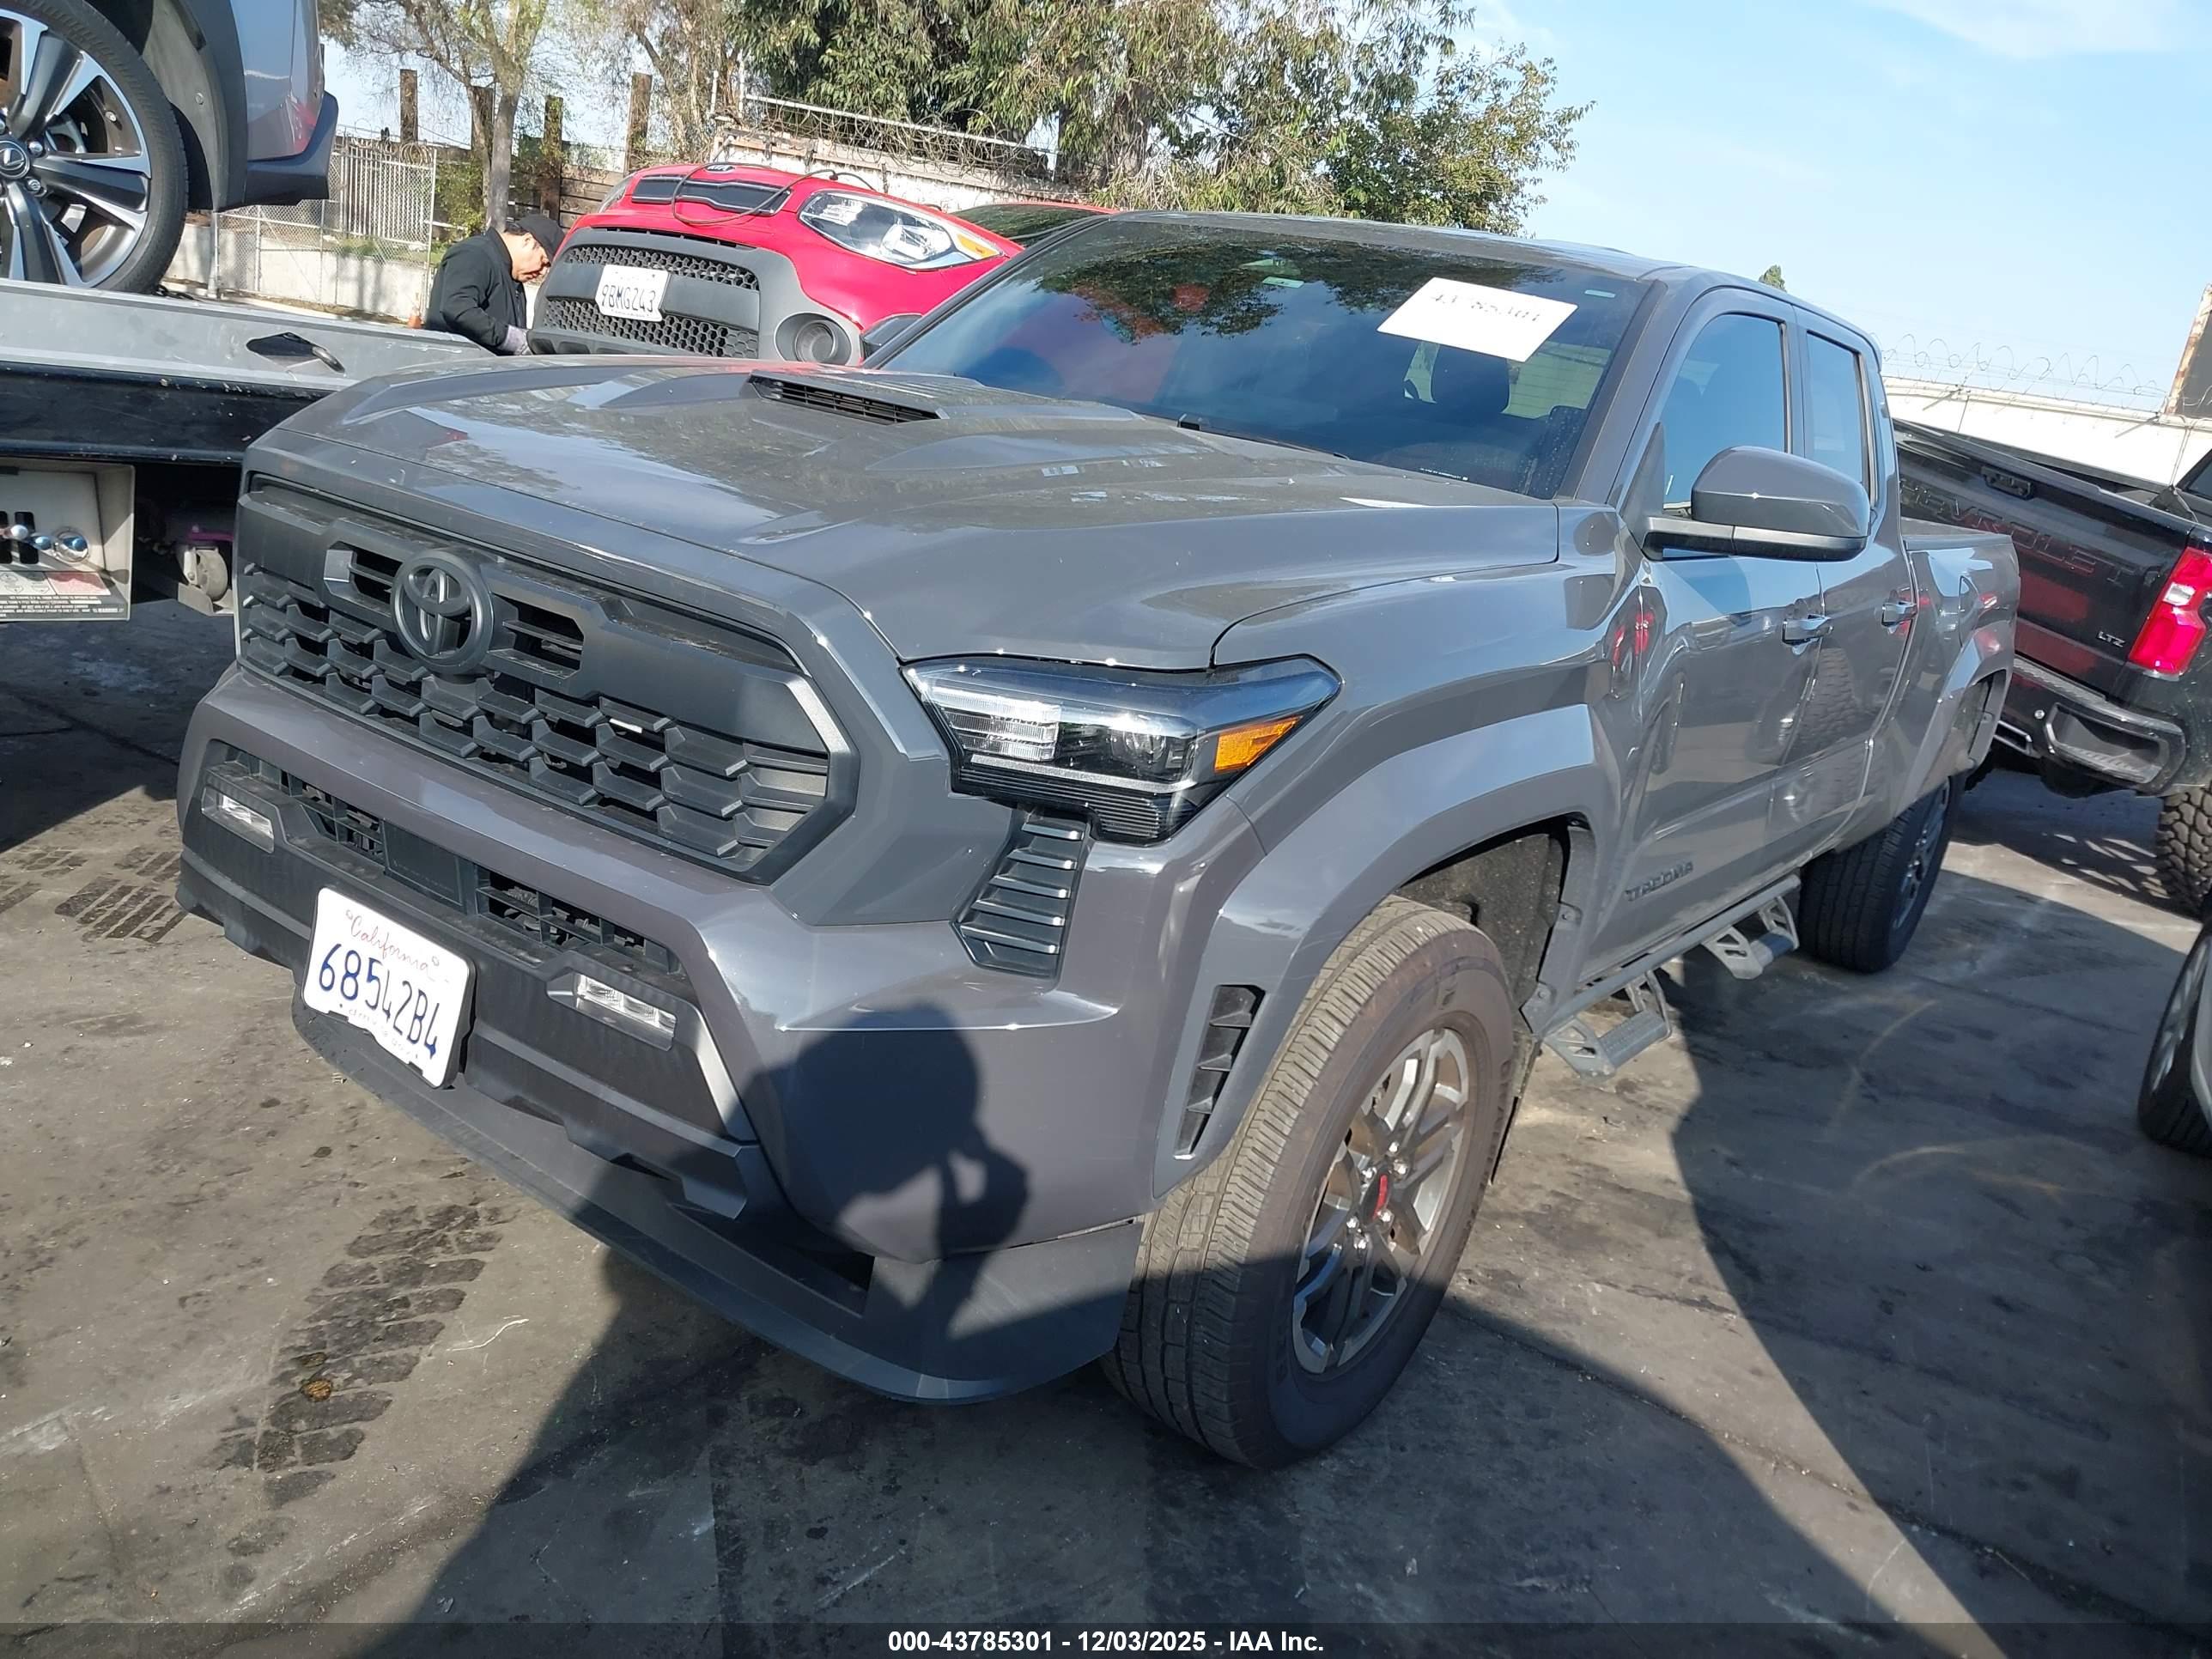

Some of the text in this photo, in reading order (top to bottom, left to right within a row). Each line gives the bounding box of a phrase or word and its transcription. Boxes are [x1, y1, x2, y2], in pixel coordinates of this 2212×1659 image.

[2098, 630, 2126, 649] LTZ
[1624, 860, 1694, 902] TACOMA
[350, 915, 430, 974] California
[319, 943, 441, 1060] 68542B4
